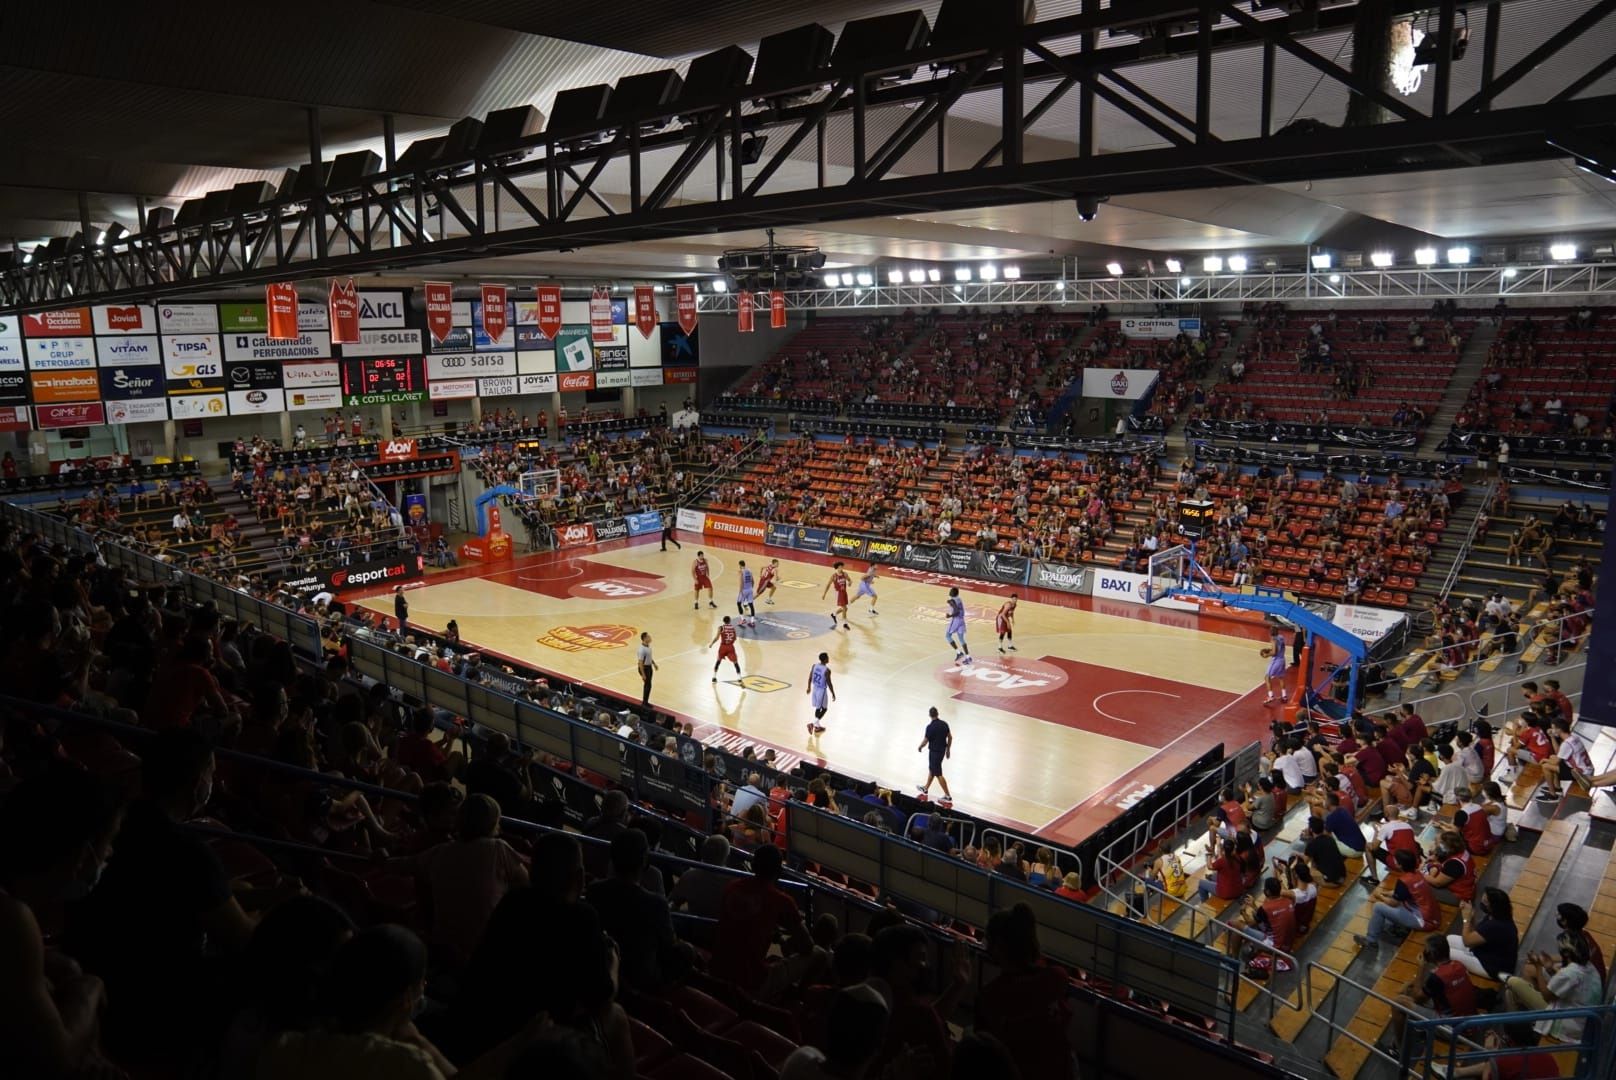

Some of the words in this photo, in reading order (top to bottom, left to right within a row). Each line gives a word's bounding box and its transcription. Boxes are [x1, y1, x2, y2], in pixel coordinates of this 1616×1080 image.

[176, 343, 208, 351] TIPSA
[253, 347, 319, 358] PERFORACIONS
[35, 359, 90, 367] PETROBAGES
[375, 360, 396, 368] 06:56
[471, 355, 504, 366] sarsa
[196, 364, 216, 375] GLS
[53, 376, 97, 387] innotech
[113, 376, 154, 388] Señor
[369, 374, 379, 382] 02
[483, 379, 512, 387] BROWN
[524, 376, 553, 384] JOYSAT
[484, 386, 512, 395] TAILOR
[362, 395, 386, 404] COTS
[391, 393, 423, 401] CLARET
[385, 441, 412, 454] AON
[564, 526, 588, 540] AON
[596, 524, 627, 537] SPALDING
[713, 521, 744, 535] ESTRELLA
[744, 527, 764, 537] DAMM
[834, 537, 860, 547] MUNDO
[870, 542, 897, 552] MUNDO
[347, 564, 406, 583] esportcat
[1039, 570, 1082, 585] SPALDING
[1101, 578, 1131, 592] BAXI
[725, 632, 733, 641] 32
[813, 672, 821, 685] 22
